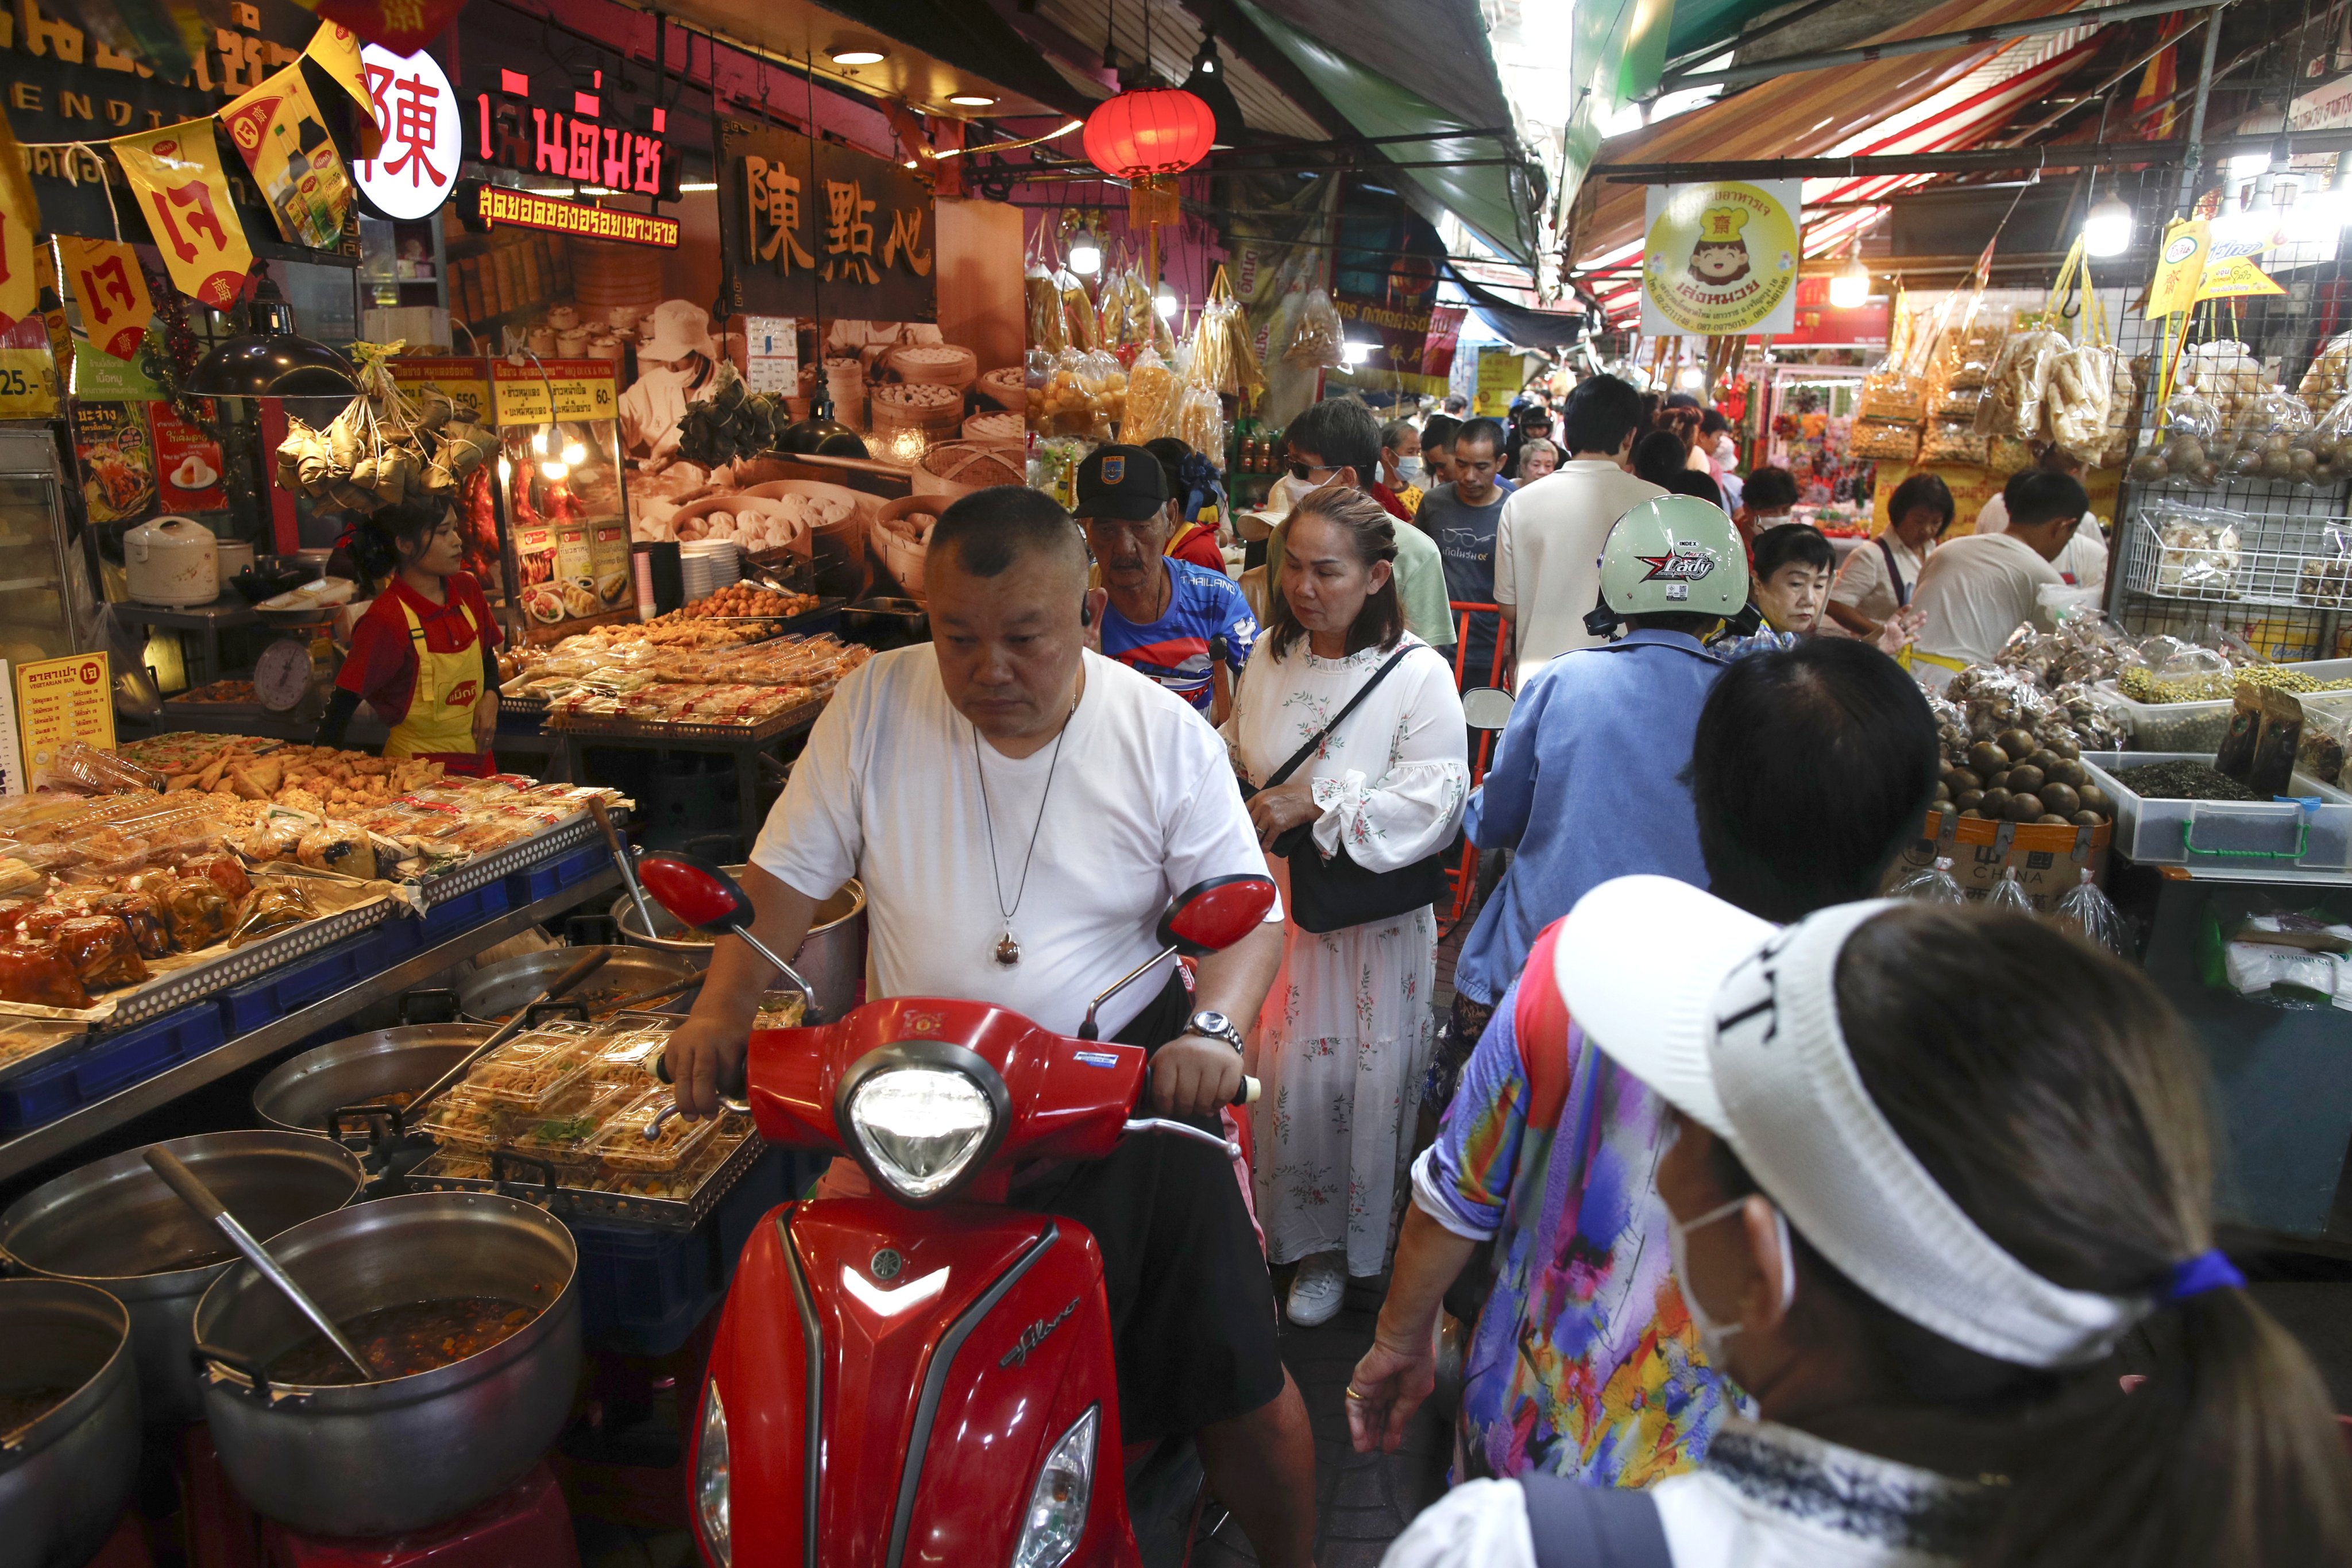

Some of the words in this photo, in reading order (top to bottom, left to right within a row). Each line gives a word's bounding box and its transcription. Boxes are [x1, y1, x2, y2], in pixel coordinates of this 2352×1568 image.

[236, 120, 256, 145] เจ
[364, 61, 447, 188] 陳
[152, 180, 227, 264] เจ
[480, 187, 678, 245] สุดยอดของอร่อยเยาวราช
[80, 256, 136, 325] เจ
[1659, 557, 1714, 580] Lady
[1180, 576, 1235, 596] THAILAND
[29, 666, 77, 682] ซาลาเปา
[83, 667, 98, 681] เจ
[29, 679, 62, 689] VEGETARIAN
[1973, 866, 2044, 884] CHNA
[1014, 1296, 1081, 1368] Filano
